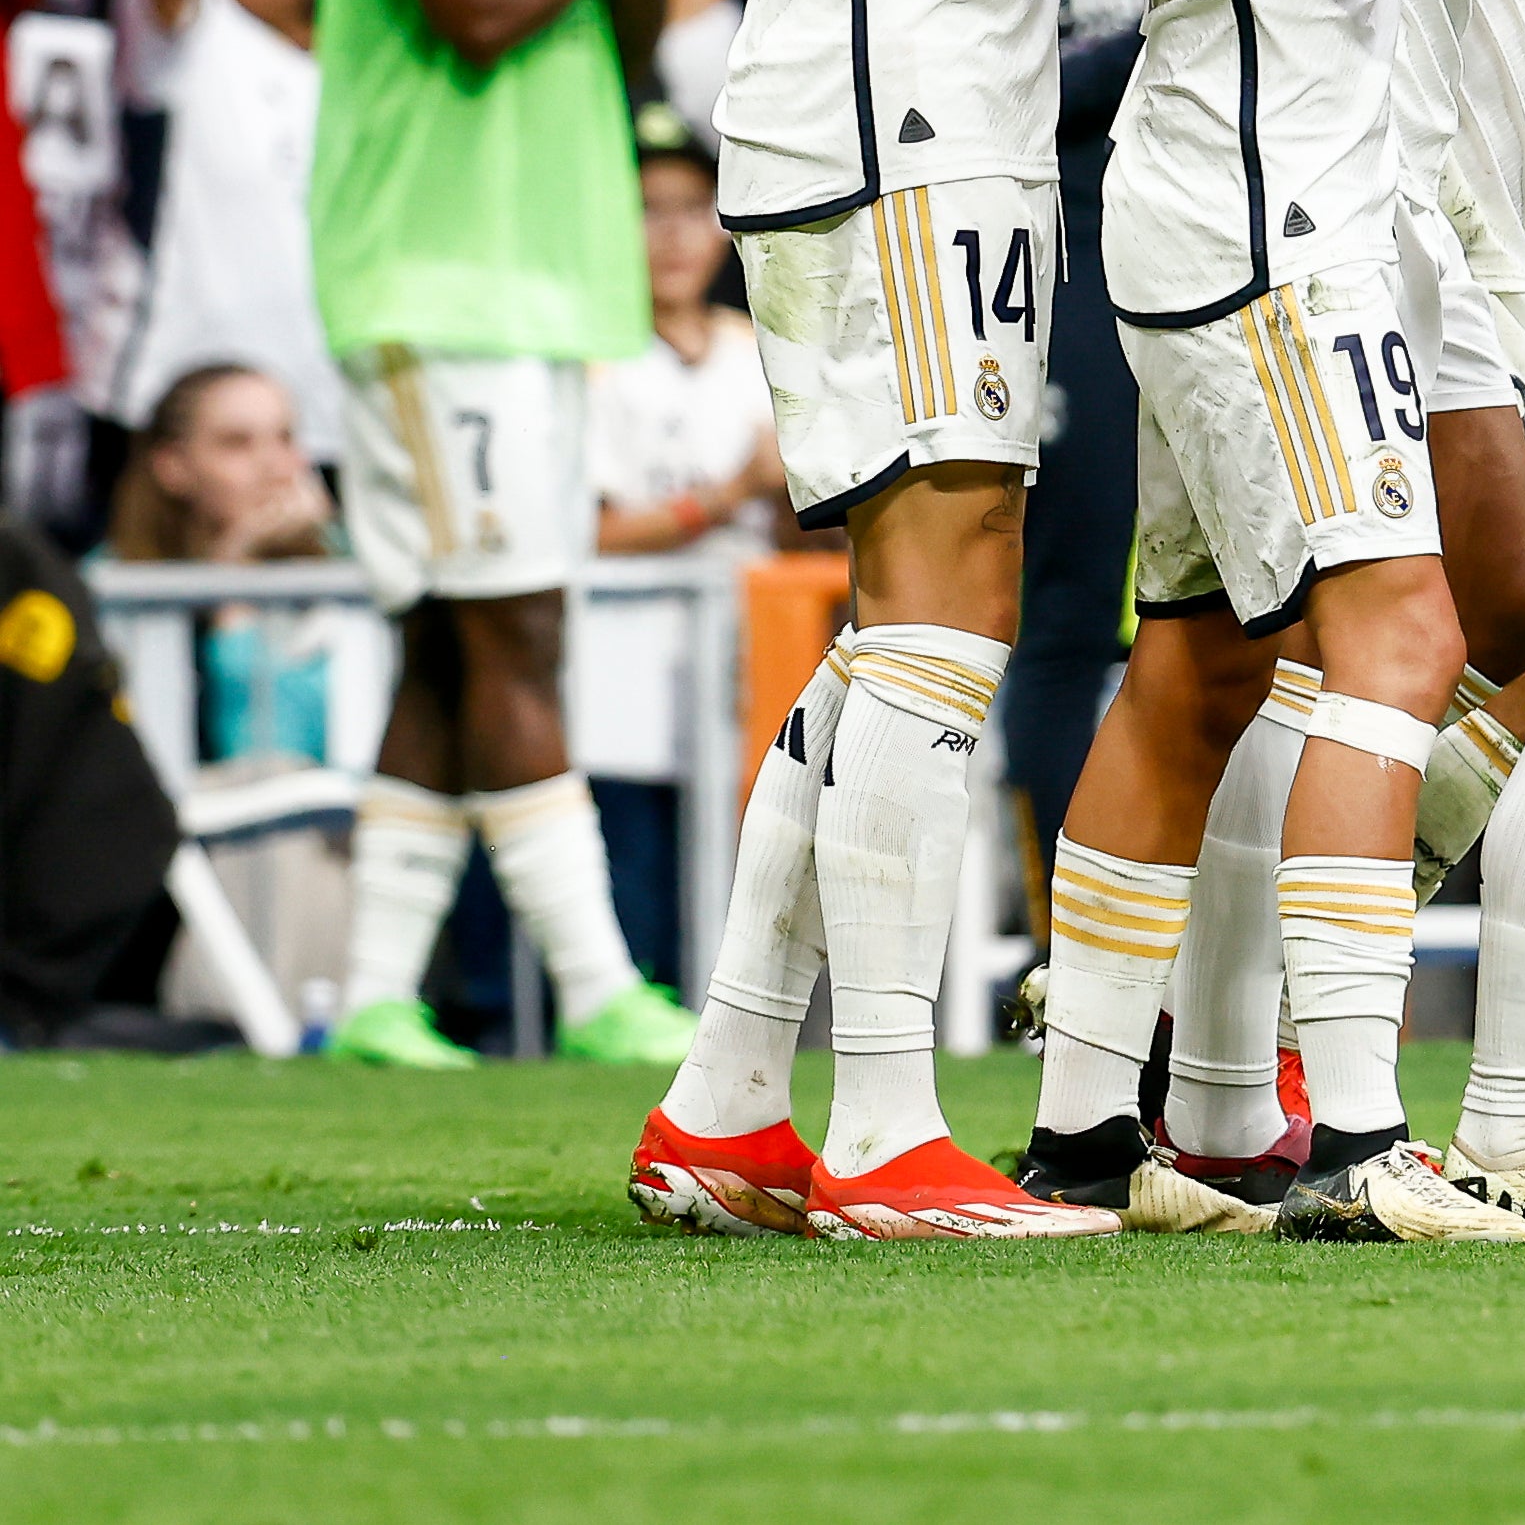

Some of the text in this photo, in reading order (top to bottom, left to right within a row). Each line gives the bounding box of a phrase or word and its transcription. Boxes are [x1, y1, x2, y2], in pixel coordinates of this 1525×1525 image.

[952, 228, 1036, 343] 14
[1332, 330, 1425, 442] 19
[452, 406, 496, 498] 7
[930, 729, 979, 757] RM
